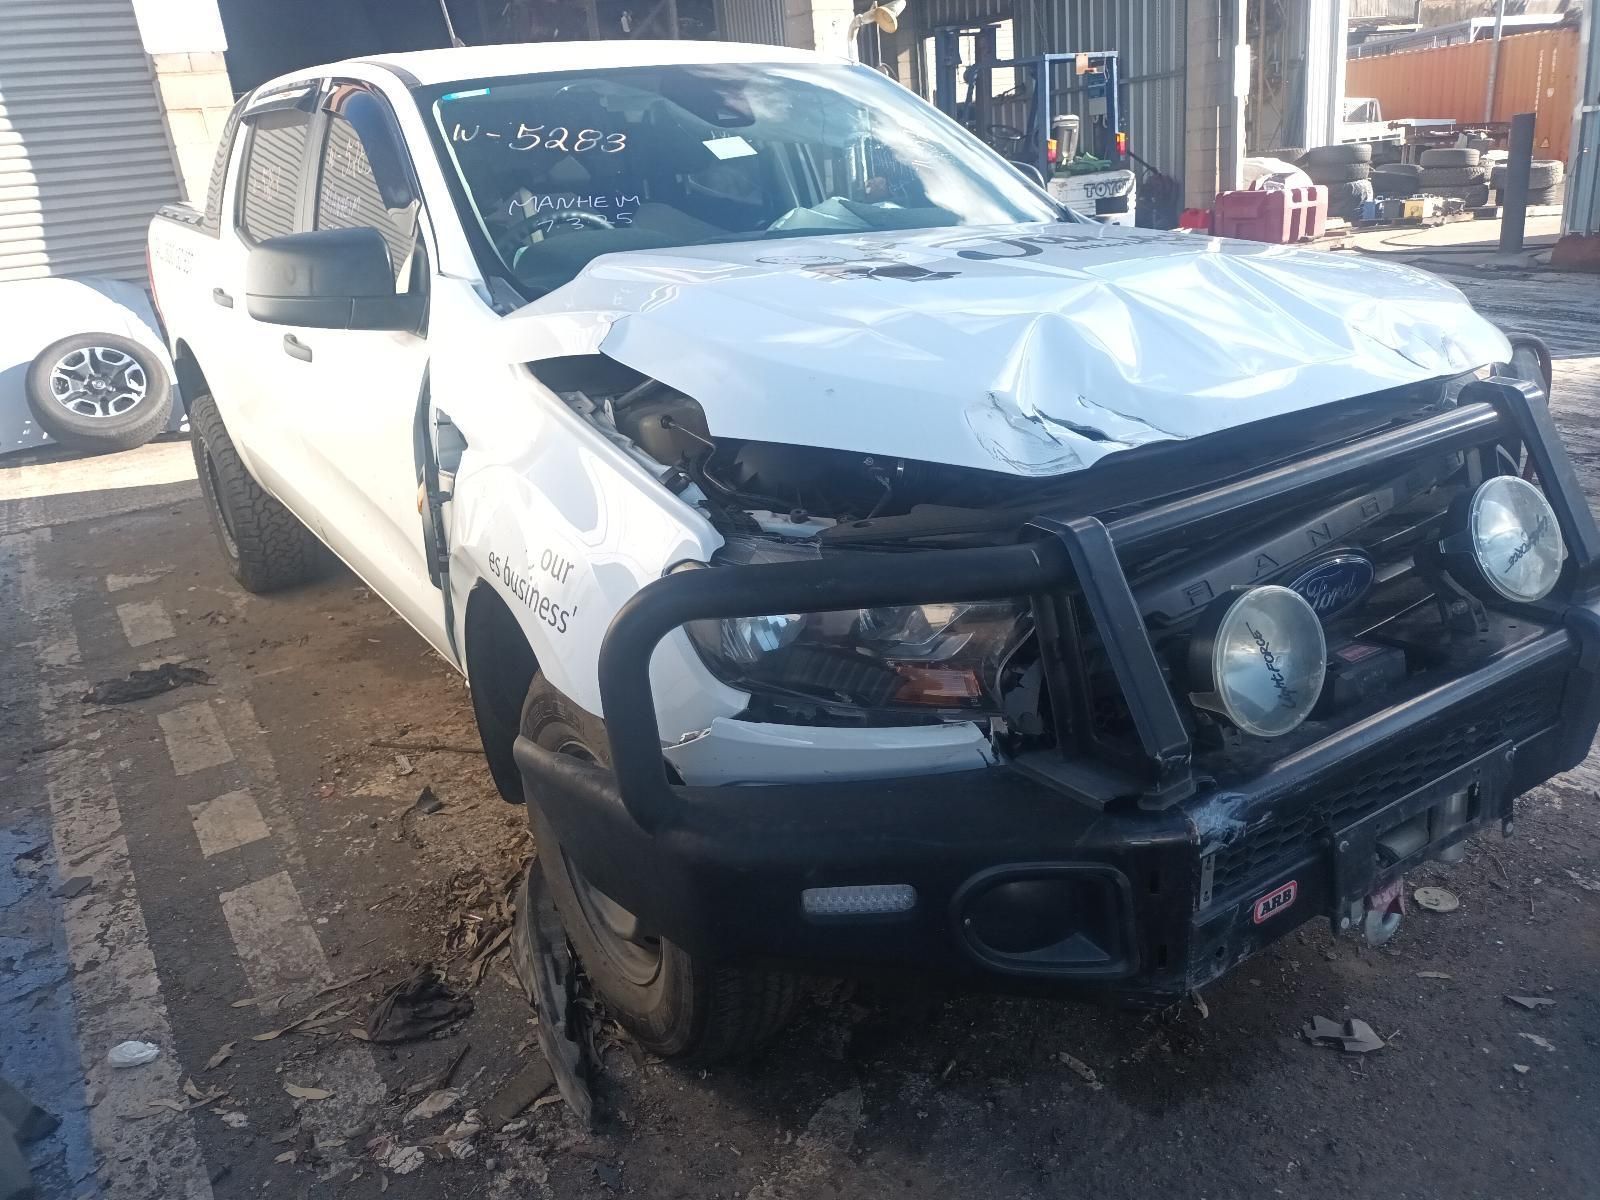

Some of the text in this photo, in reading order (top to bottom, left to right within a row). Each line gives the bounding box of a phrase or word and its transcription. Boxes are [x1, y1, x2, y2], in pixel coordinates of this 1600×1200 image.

[1083, 181, 1129, 198] TOYO
[509, 195, 641, 216] MANHEIM
[541, 548, 575, 584] our
[1306, 569, 1357, 611] Ford
[1260, 888, 1292, 916] ARB
